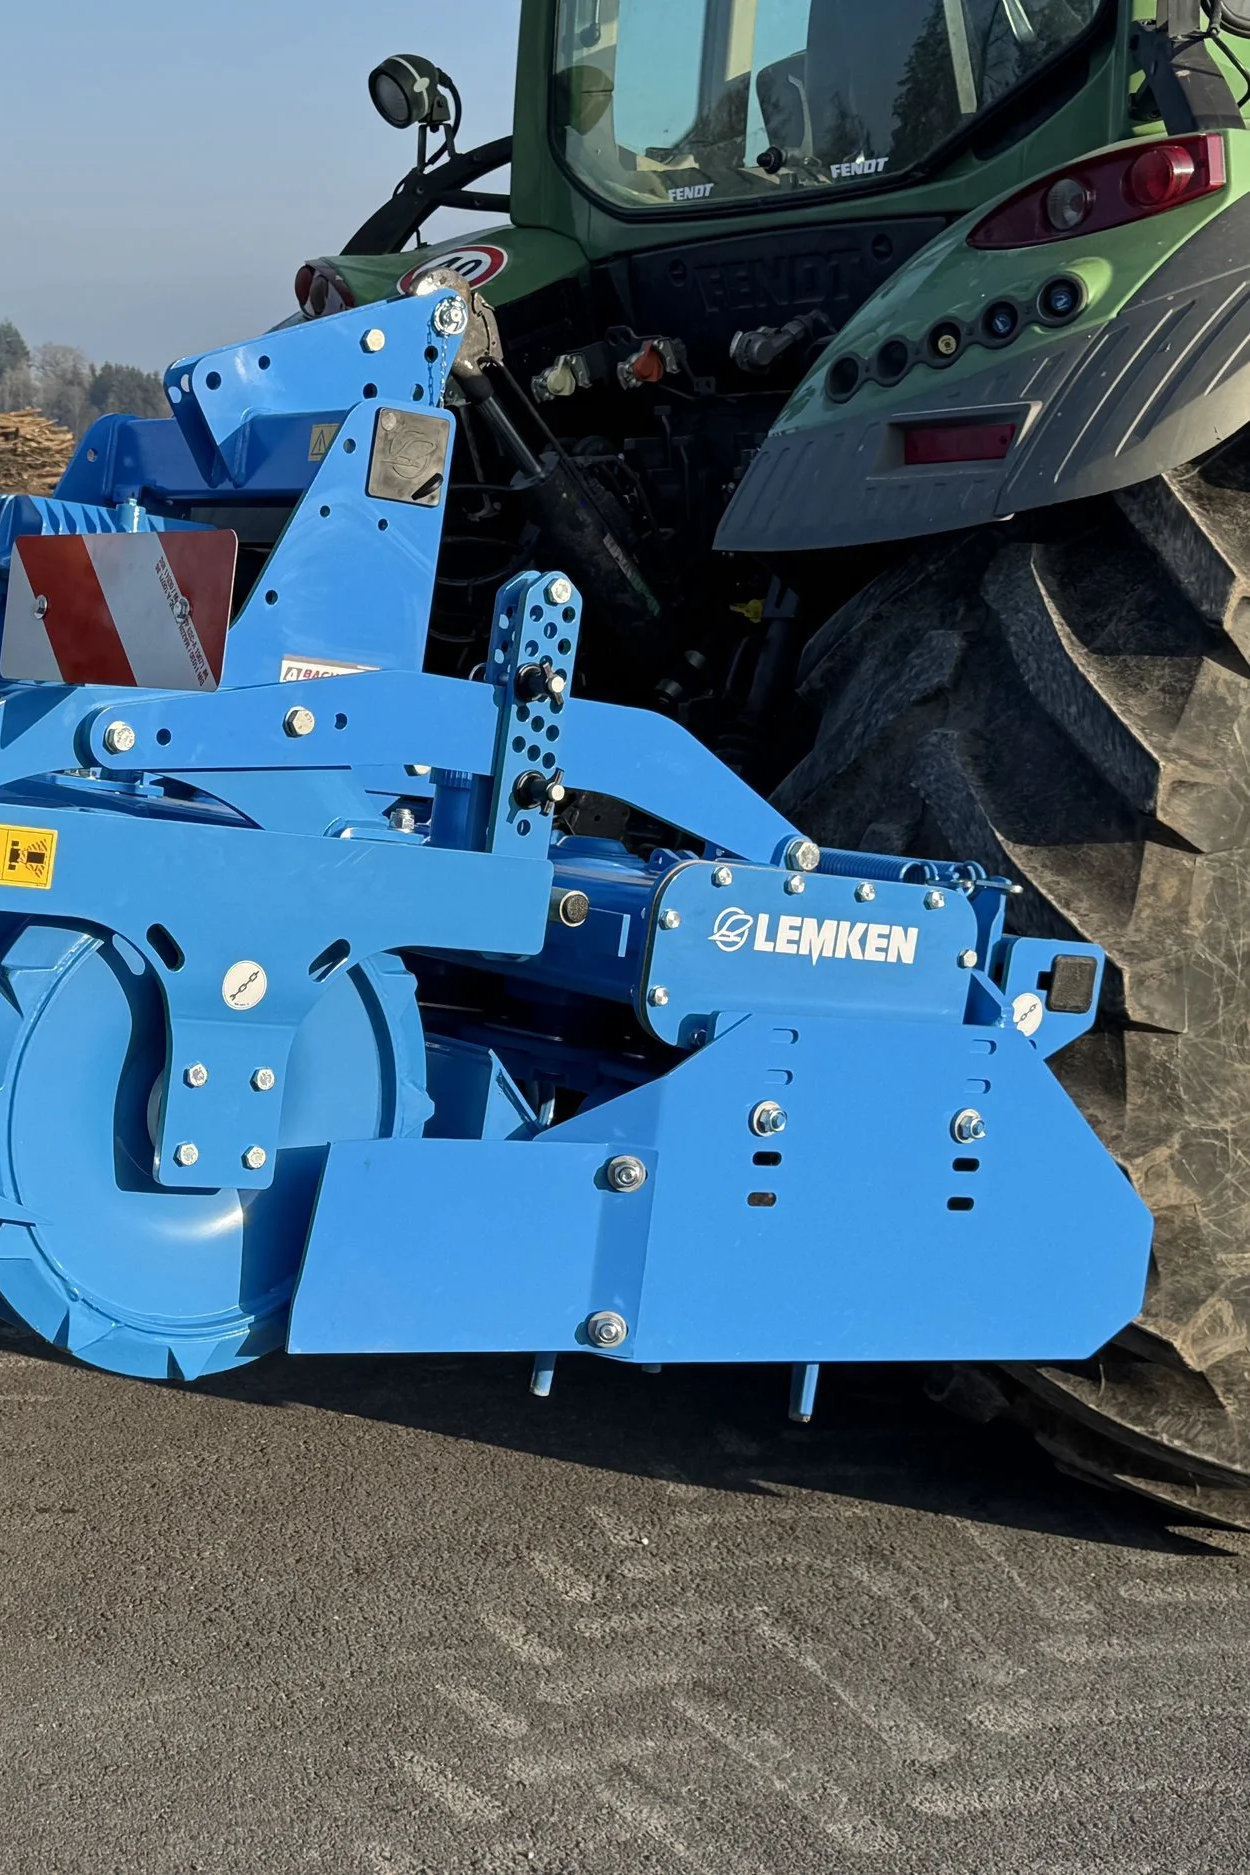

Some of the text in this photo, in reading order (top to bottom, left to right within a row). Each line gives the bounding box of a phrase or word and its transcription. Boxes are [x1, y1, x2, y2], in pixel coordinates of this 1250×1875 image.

[830, 157, 889, 179] FENDT
[668, 183, 714, 201] FENDT
[694, 248, 862, 312] FENDT
[753, 913, 919, 966] LEMKEN
